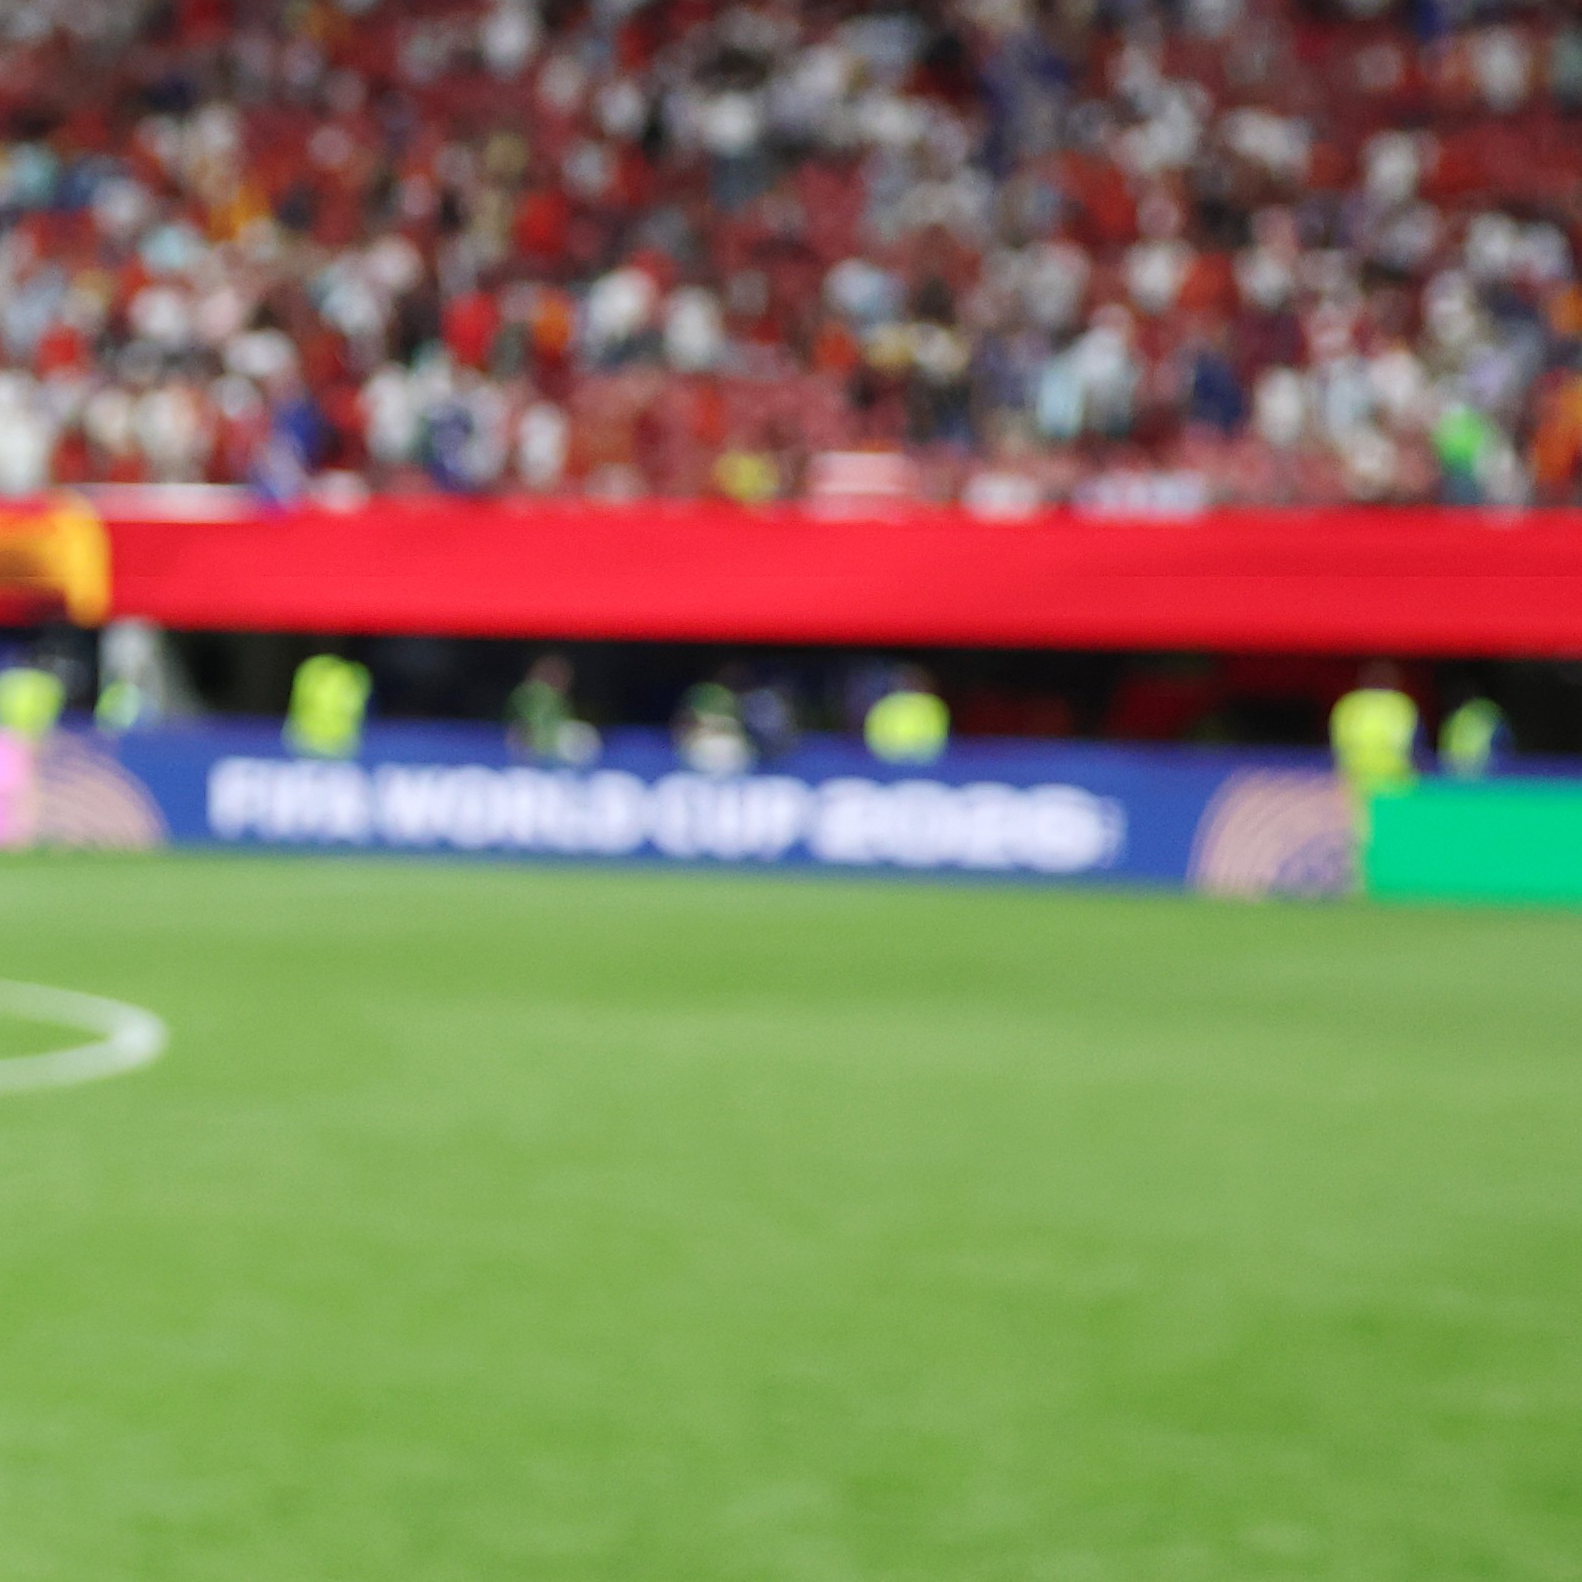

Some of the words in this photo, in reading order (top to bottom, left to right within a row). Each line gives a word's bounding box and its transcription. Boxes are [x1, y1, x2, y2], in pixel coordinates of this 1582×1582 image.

[208, 757, 373, 845] FIFA
[375, 763, 646, 856] WORLD
[647, 771, 816, 861] CUP
[811, 778, 1112, 874] 2026
